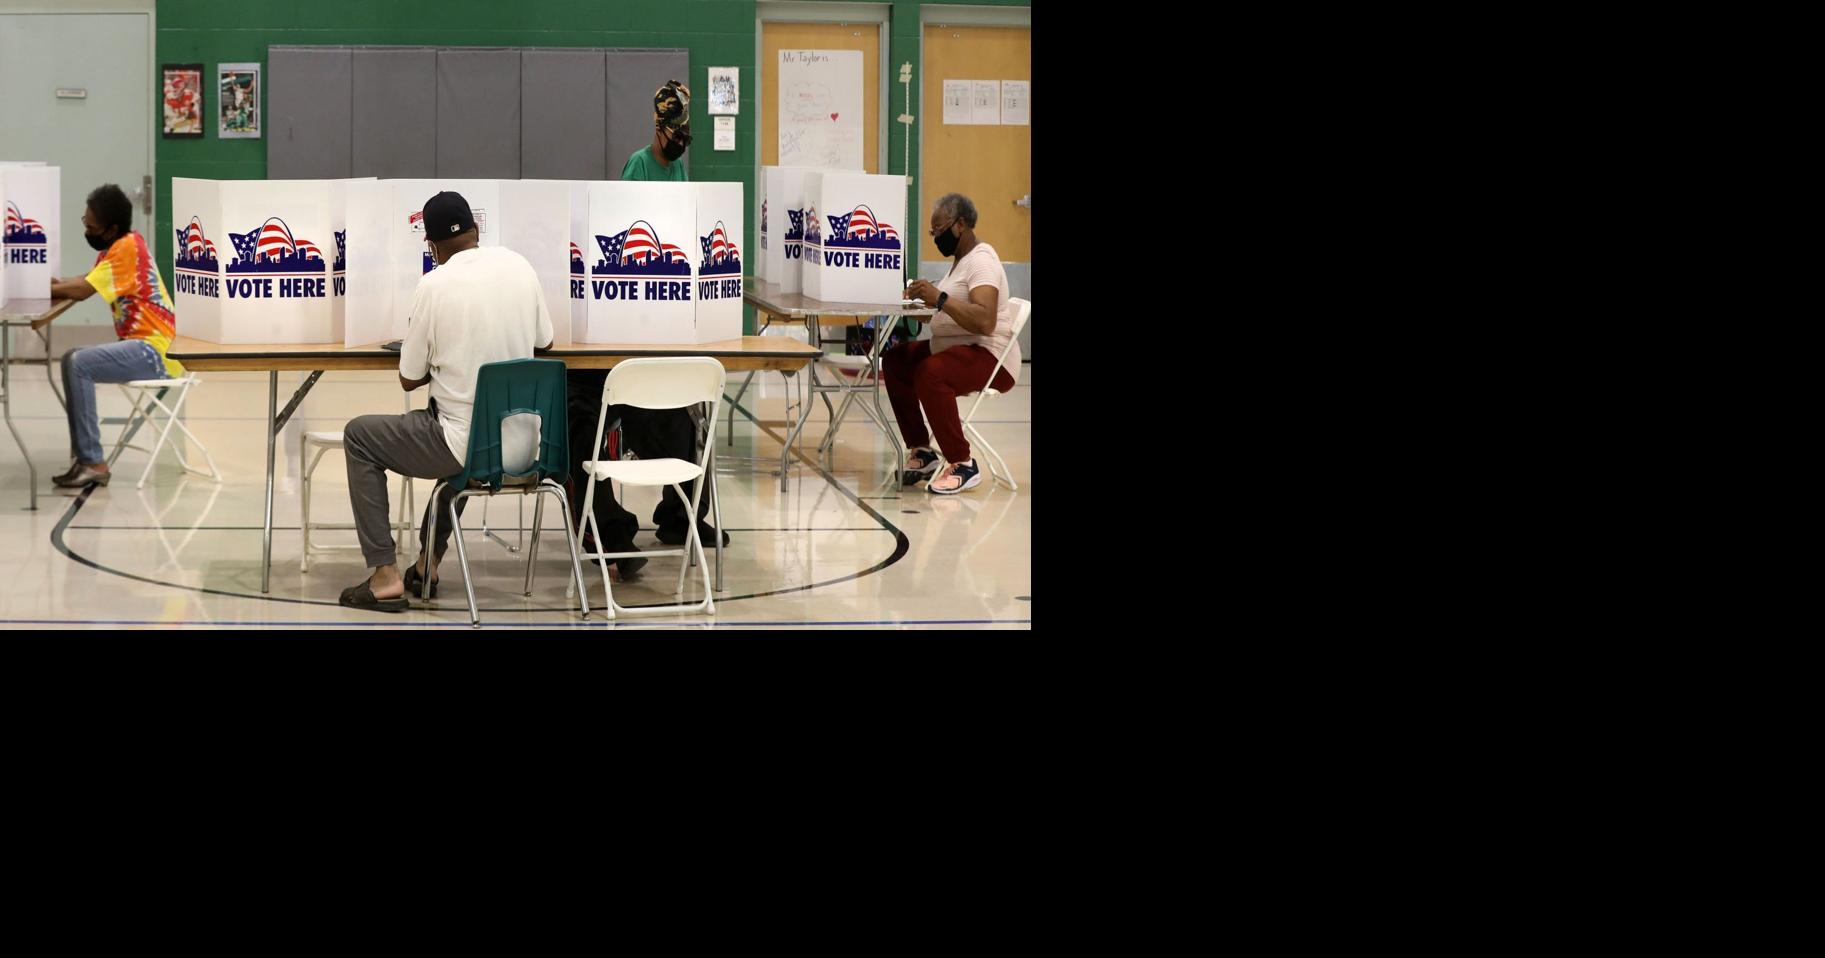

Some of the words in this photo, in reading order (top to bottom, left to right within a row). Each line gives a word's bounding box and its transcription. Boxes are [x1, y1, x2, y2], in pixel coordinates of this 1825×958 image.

[11, 249, 47, 264] HERE
[785, 244, 803, 259] VO
[824, 251, 859, 268] VOTE
[864, 253, 900, 270] HERE
[175, 273, 196, 294] VOTE
[198, 275, 219, 298] HERE
[226, 279, 273, 298] VOTE
[279, 278, 326, 298] HERE
[333, 277, 346, 297] VO
[570, 279, 585, 299] RE
[592, 280, 638, 300] VOTE
[645, 281, 691, 300] HERE
[699, 280, 719, 300] VOTE
[721, 279, 741, 299] HERE
